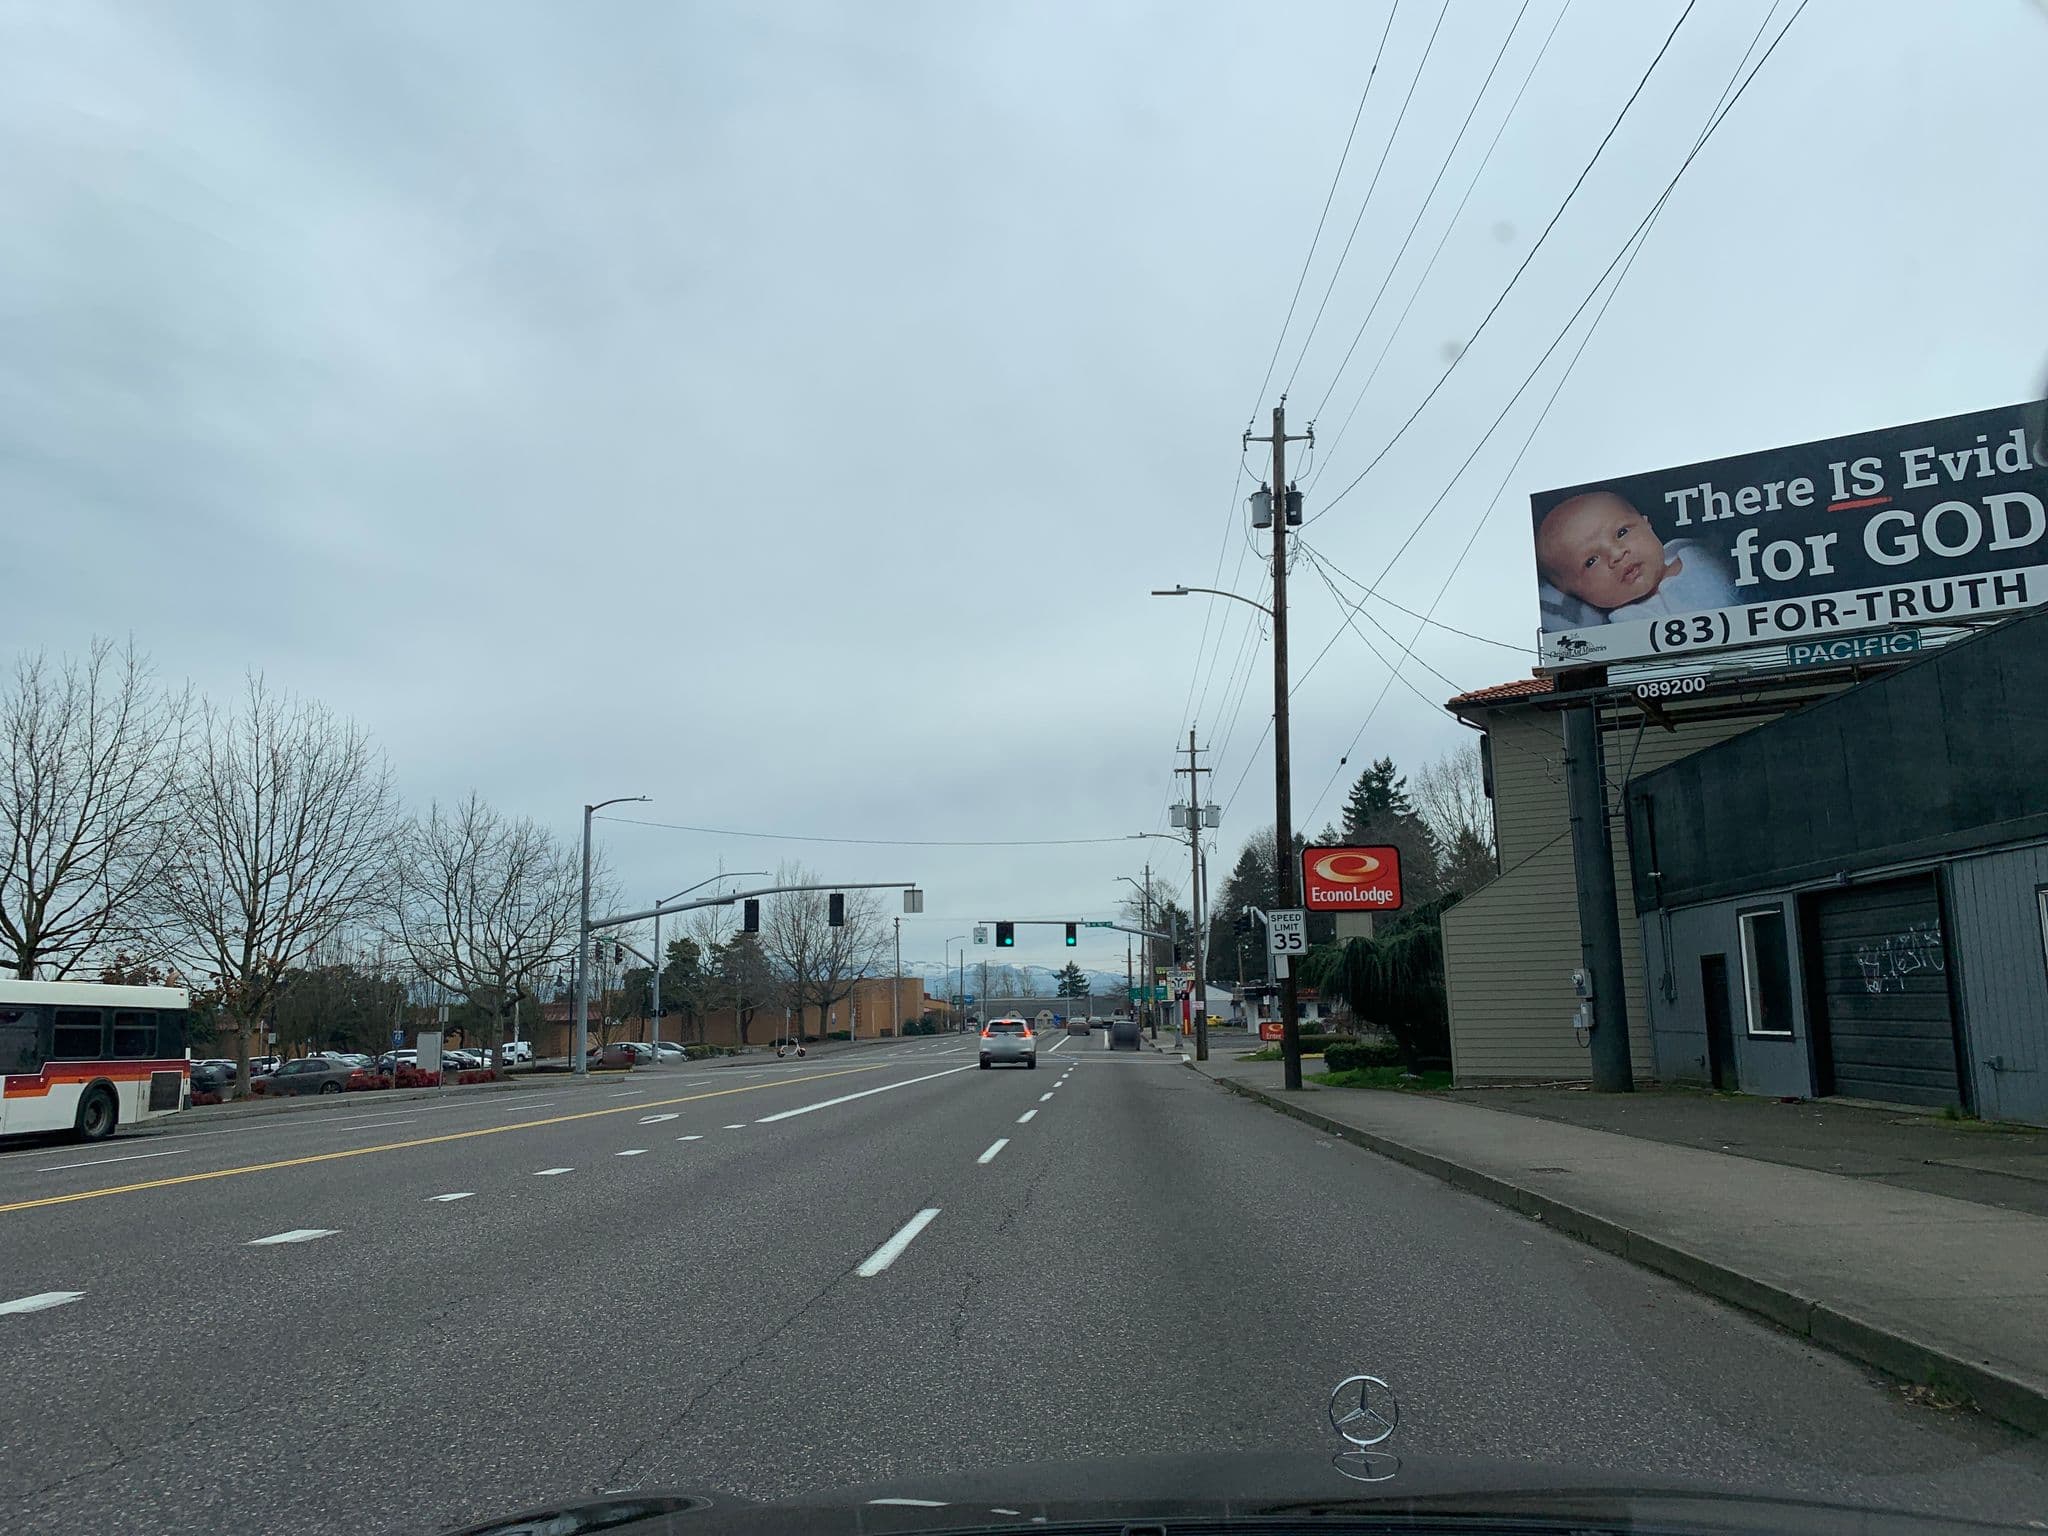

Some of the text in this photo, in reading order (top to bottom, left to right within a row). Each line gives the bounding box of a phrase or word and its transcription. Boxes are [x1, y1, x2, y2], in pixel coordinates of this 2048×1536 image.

[1665, 477, 1815, 527] There
[1828, 457, 1885, 501] IS
[1731, 492, 2047, 587] for GOD
[1649, 573, 2029, 653] (83) FOR-TRUTH
[1637, 677, 1706, 698] 089200
[1311, 886, 1394, 904] EconoLodge
[1270, 914, 1302, 922] SPEED
[1274, 923, 1299, 932] LIMIT
[1274, 933, 1303, 950] 35
